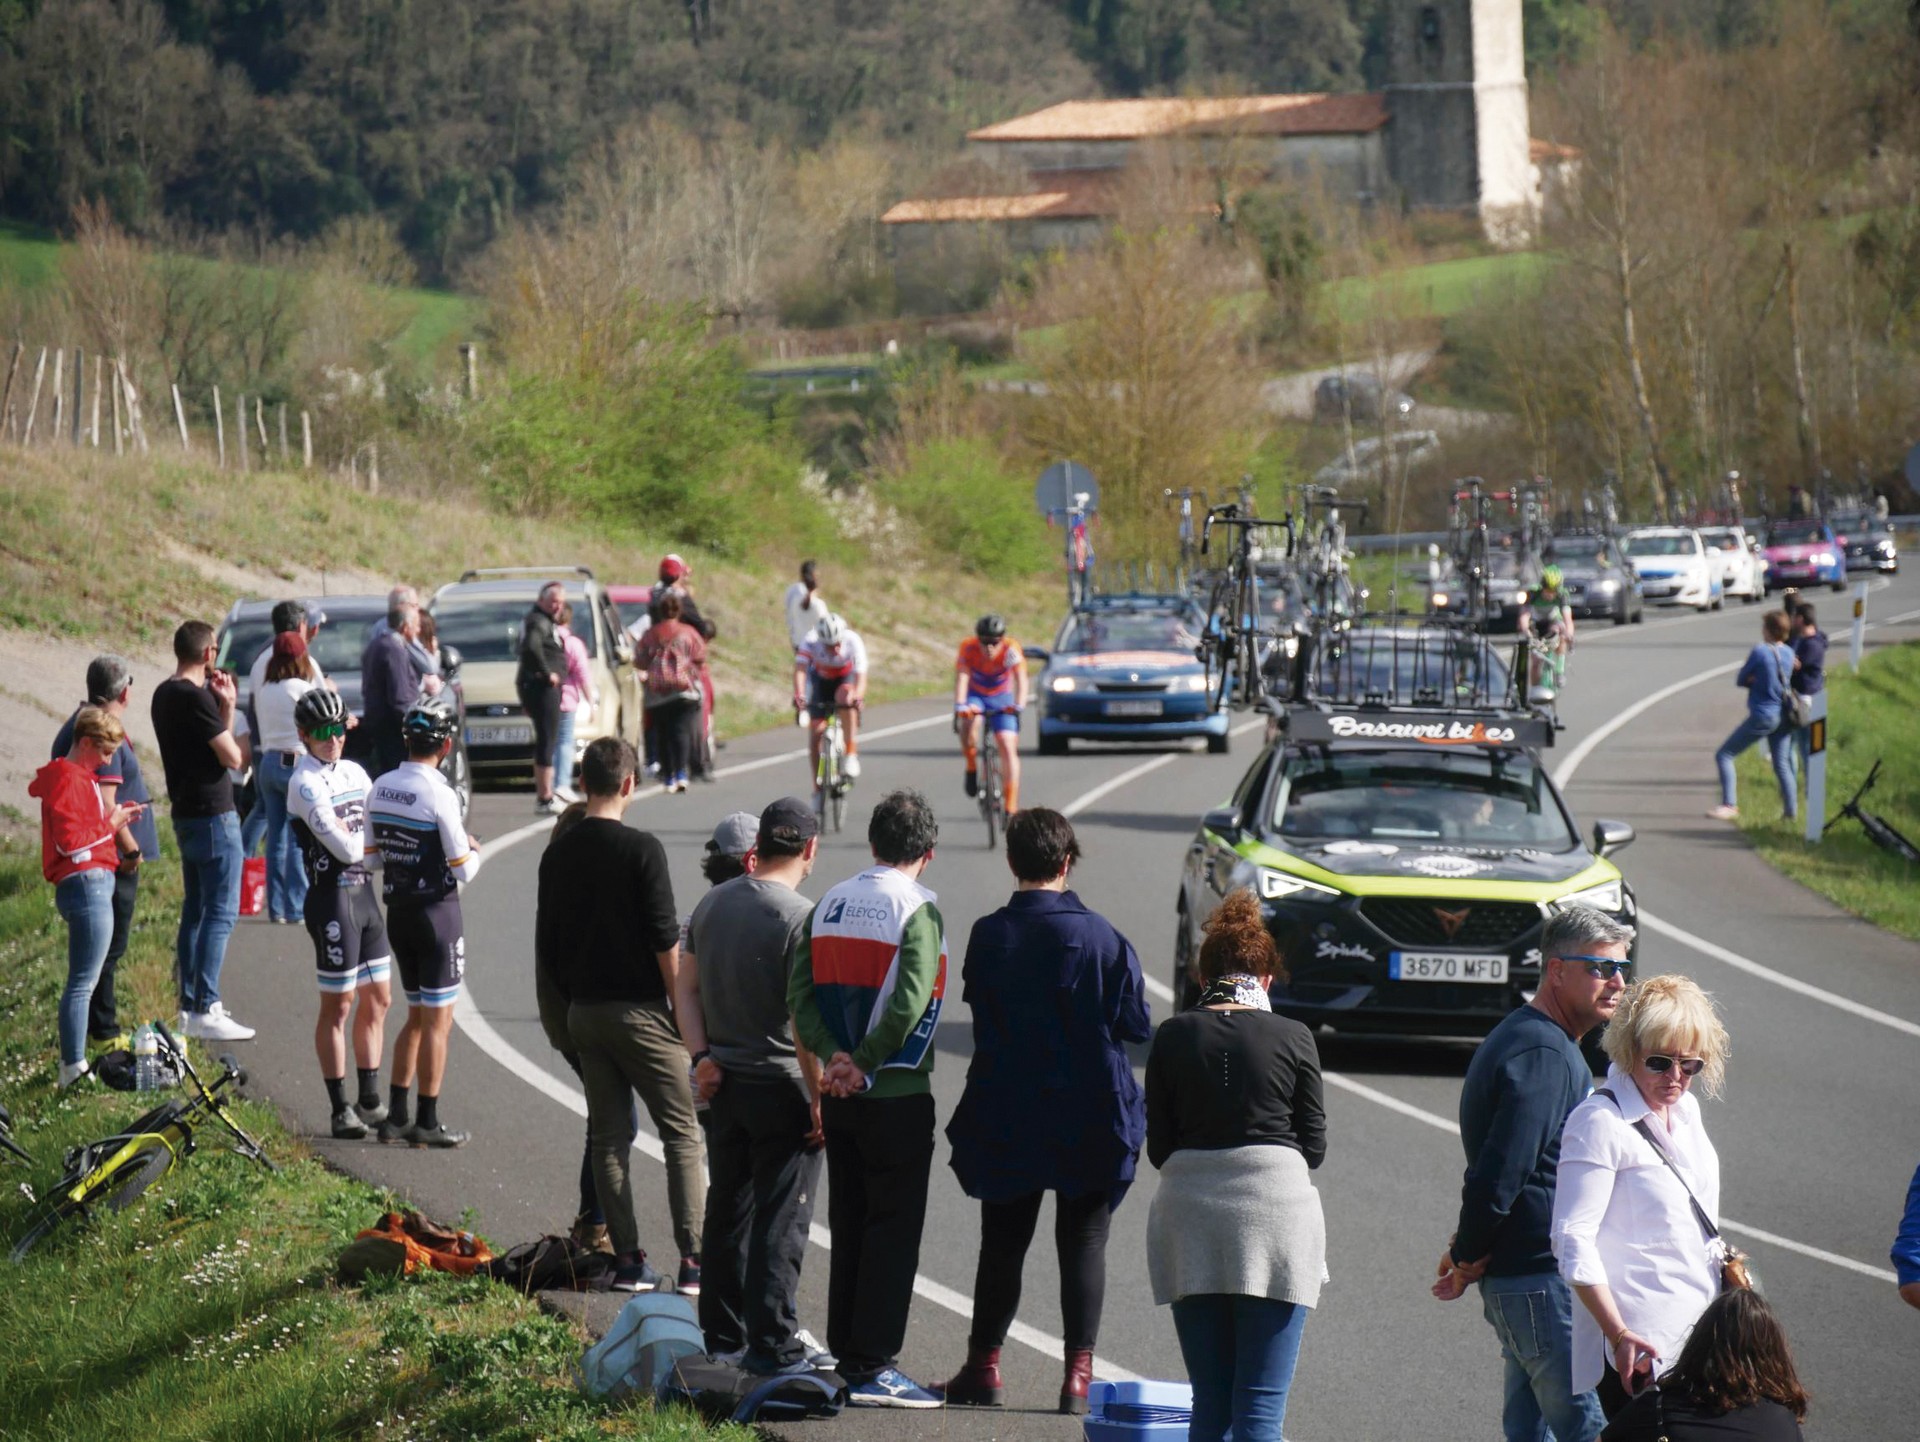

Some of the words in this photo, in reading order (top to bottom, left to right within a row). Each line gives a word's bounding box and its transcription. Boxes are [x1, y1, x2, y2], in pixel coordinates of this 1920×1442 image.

[1328, 716, 1445, 738] Basauri
[845, 905, 888, 921] ELEYCO
[1405, 957, 1457, 977] 3670
[1464, 959, 1503, 979] MFD
